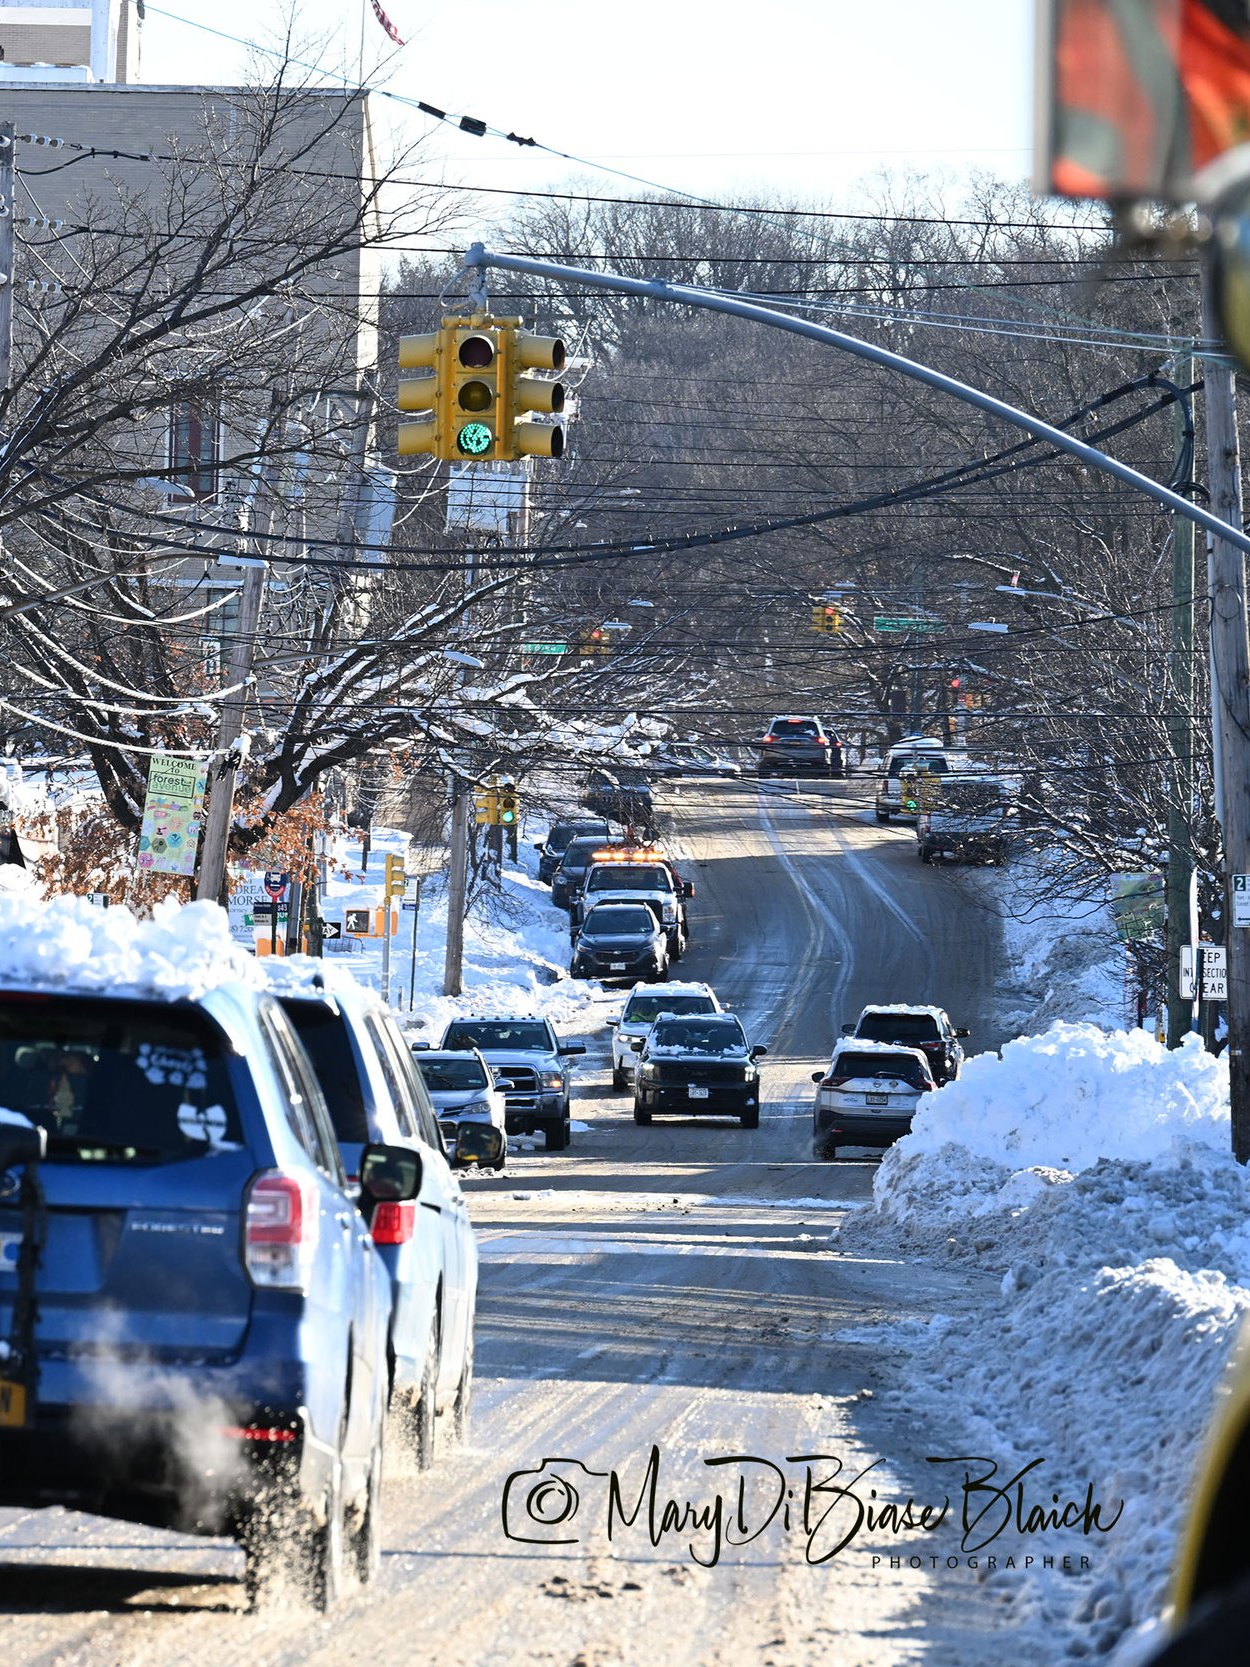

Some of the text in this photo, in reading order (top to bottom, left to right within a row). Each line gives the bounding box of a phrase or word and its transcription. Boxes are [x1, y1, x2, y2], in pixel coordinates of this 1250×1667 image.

[152, 757, 197, 771] WELCOME
[153, 773, 188, 786] forest
[152, 781, 191, 794] avenue
[1236, 877, 1244, 890] 2
[1202, 952, 1221, 963] EEP
[1183, 968, 1227, 979] INTSECTIO
[1189, 982, 1224, 994] CEAR
